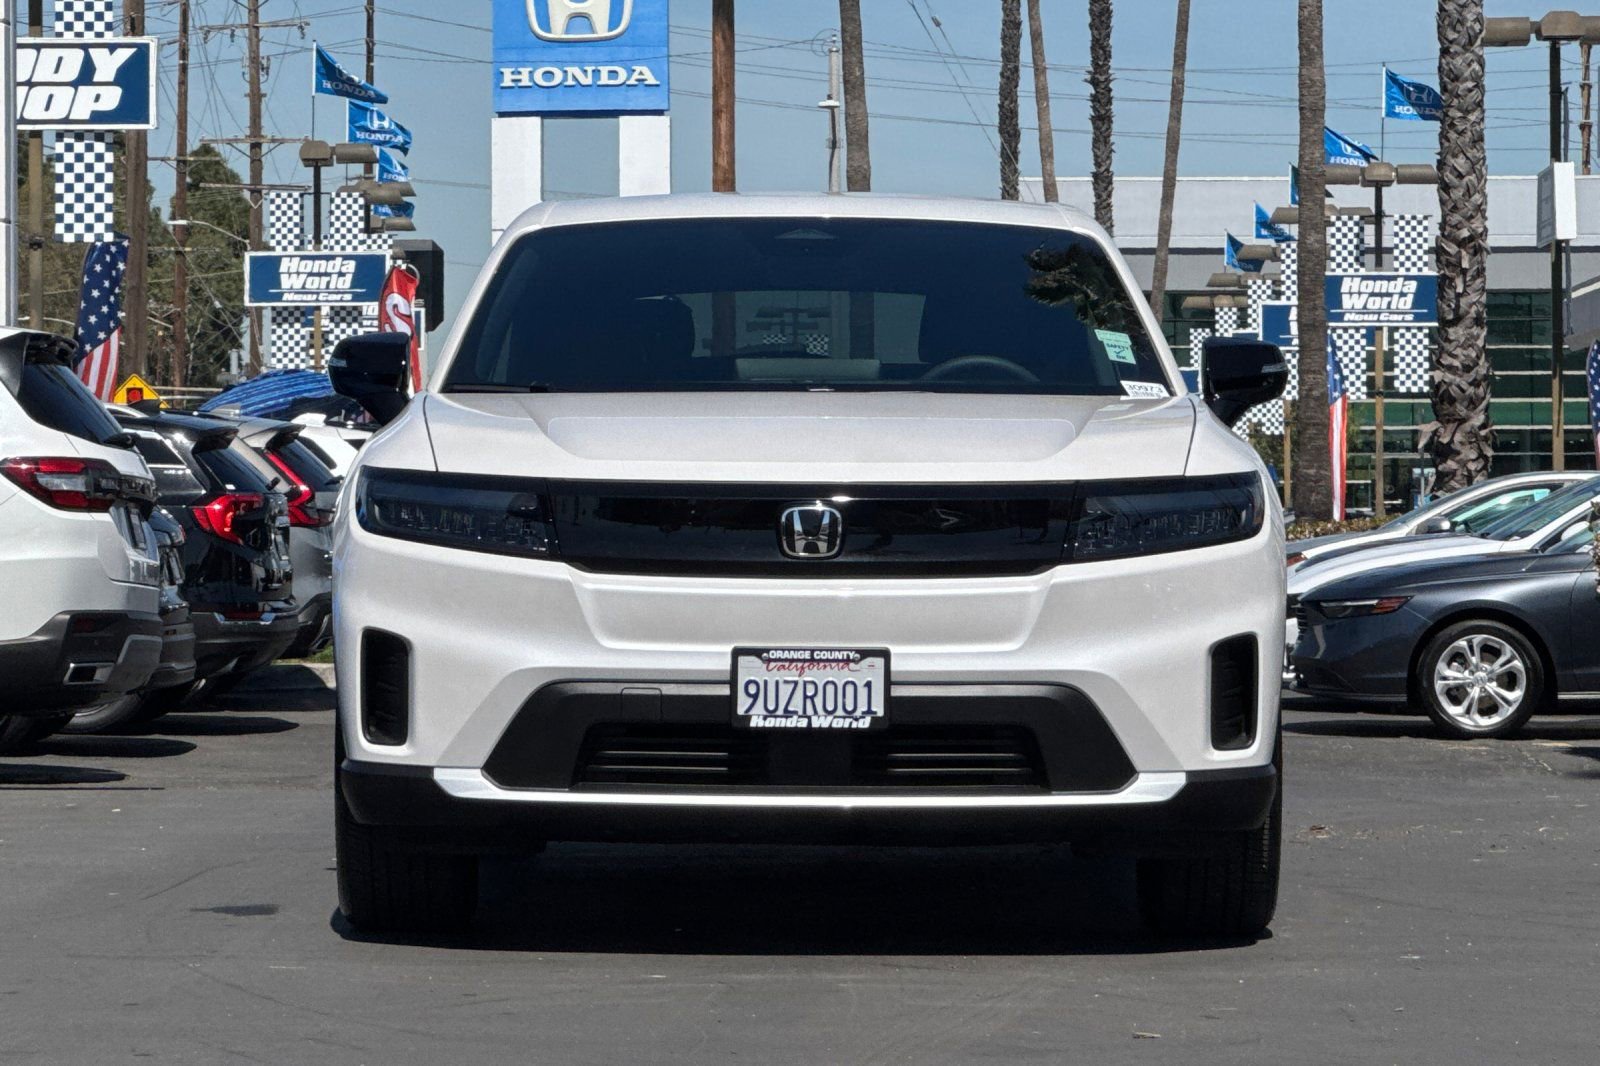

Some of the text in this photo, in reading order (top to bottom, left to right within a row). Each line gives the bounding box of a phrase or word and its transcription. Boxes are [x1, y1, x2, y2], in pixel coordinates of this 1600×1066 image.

[500, 66, 660, 87] HONDA
[322, 80, 376, 98] HONDA
[355, 131, 404, 143] HONDA
[279, 257, 356, 273] Honda
[280, 274, 354, 290] World
[1341, 277, 1418, 293] Honda
[282, 293, 353, 301] New Cars
[1342, 294, 1414, 310] World
[1343, 313, 1415, 322] New Cars
[769, 651, 856, 660] ORANGE COUNTY
[744, 679, 877, 715] 9UZR001
[750, 716, 872, 729] Honda World
